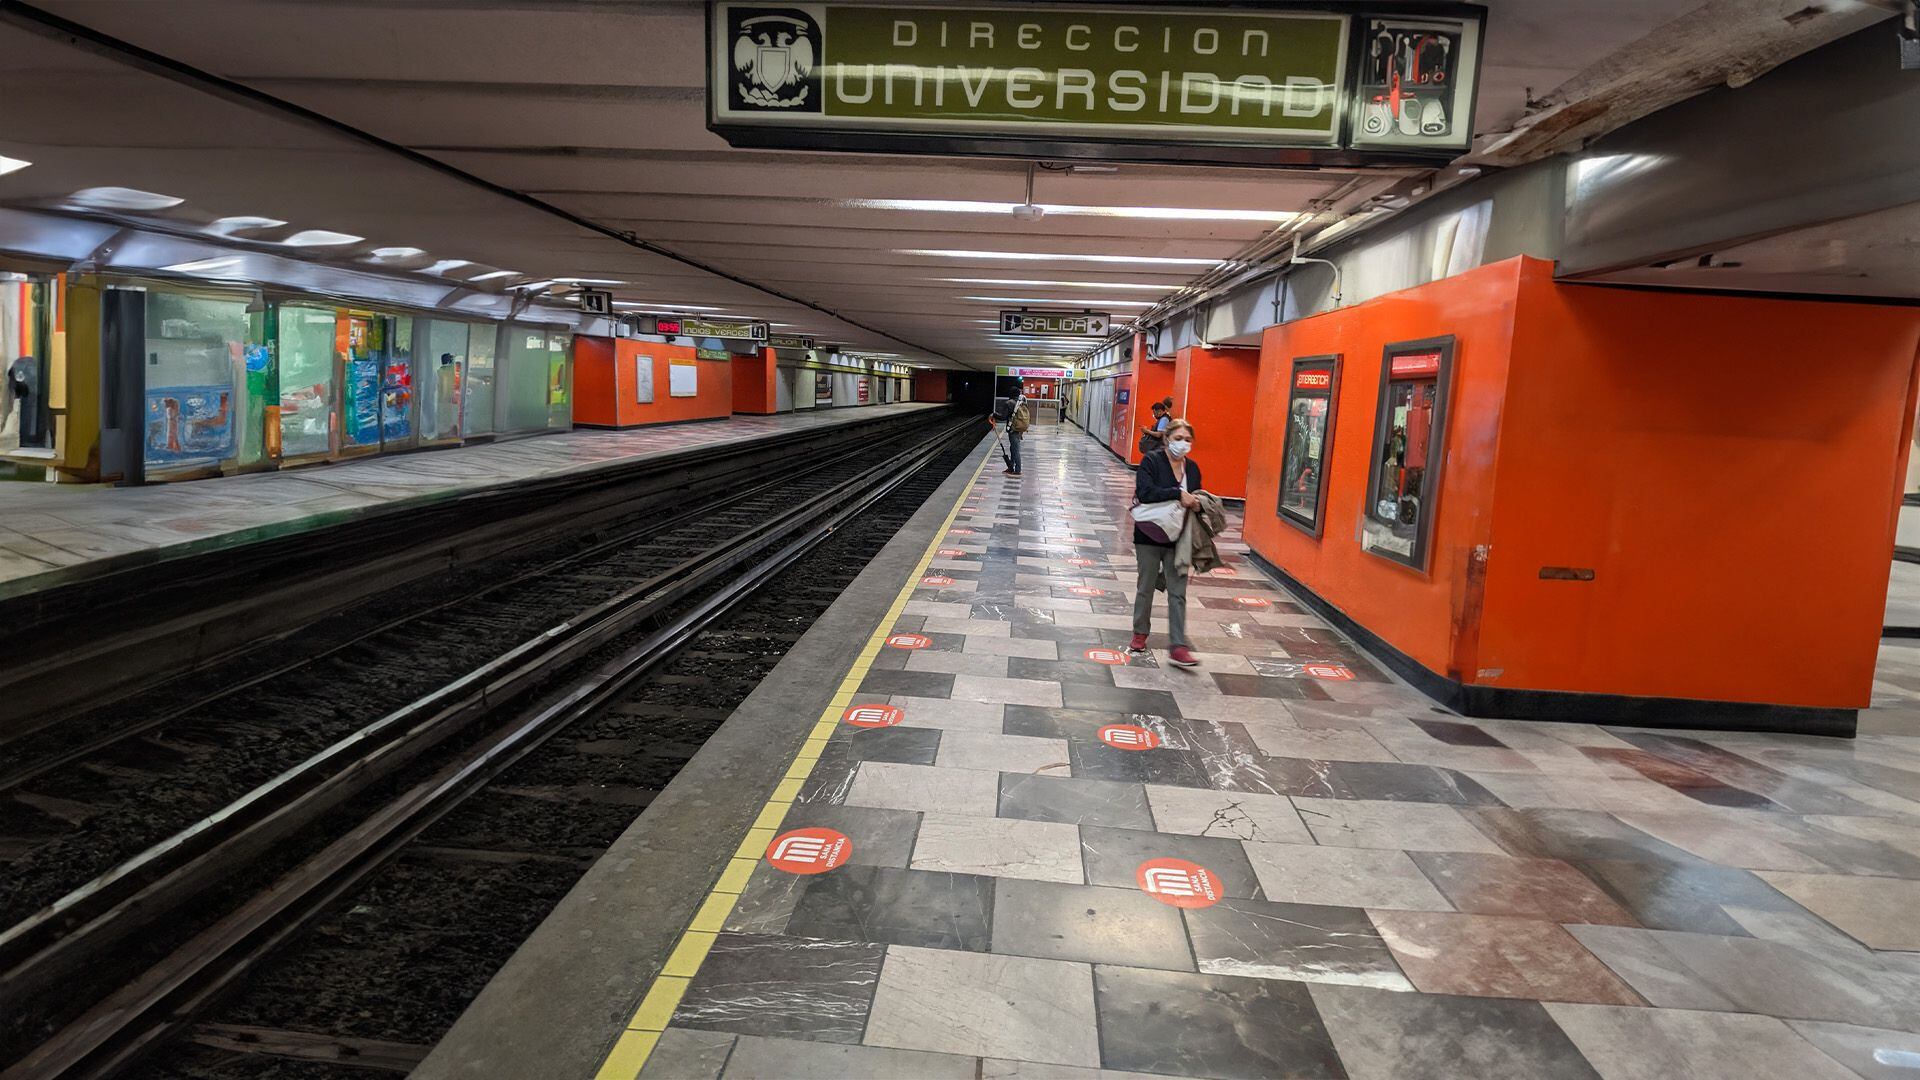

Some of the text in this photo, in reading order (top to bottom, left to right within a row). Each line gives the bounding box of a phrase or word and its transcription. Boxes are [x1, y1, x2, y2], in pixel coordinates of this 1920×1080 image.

[893, 20, 1269, 57] DIRECCION
[834, 62, 1324, 119] UNIVERSIDAD
[684, 327, 749, 337] INDIOS VERDES
[1022, 318, 1087, 331] SALIDA
[826, 838, 846, 868] DISTANCIA
